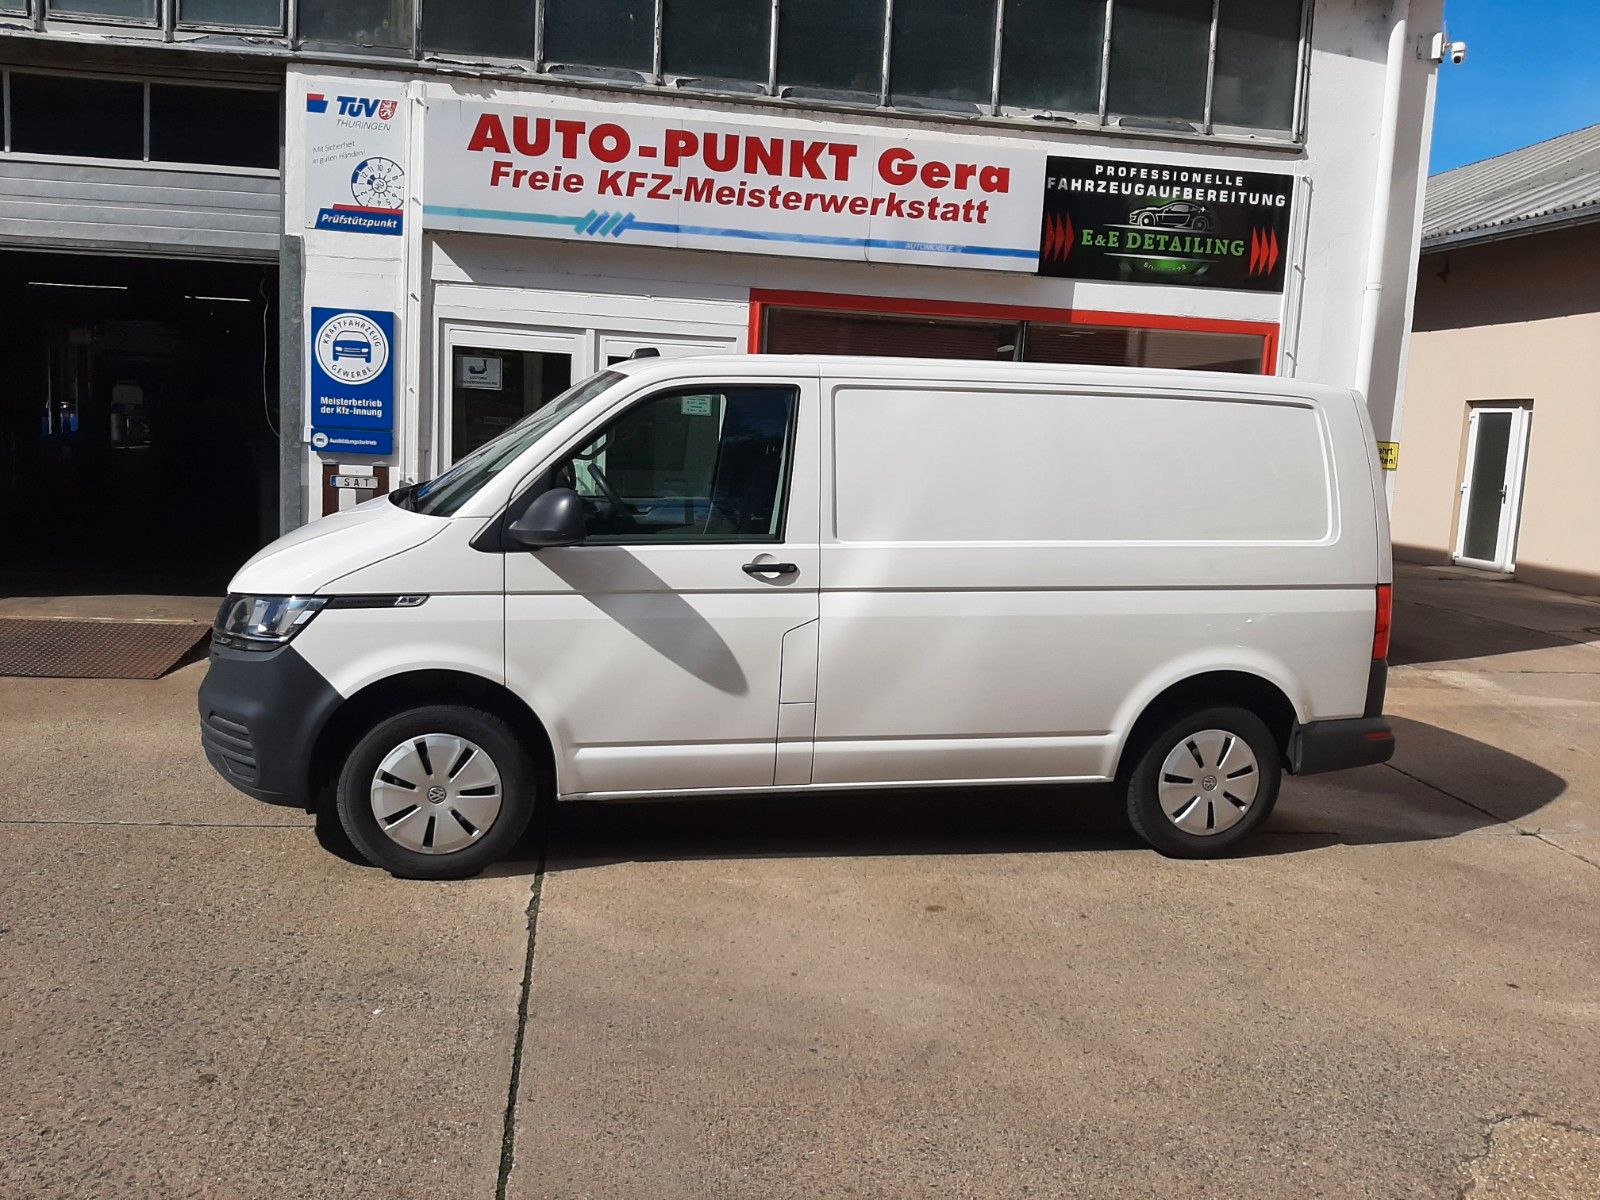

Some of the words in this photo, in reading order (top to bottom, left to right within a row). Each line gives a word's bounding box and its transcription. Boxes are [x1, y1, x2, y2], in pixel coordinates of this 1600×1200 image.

[336, 95, 380, 118] TÜV
[467, 113, 857, 181] AUTO-PUNKT
[877, 147, 1010, 193] Gera
[1095, 164, 1244, 187] PROFESSIONELLE
[490, 161, 585, 193] Freie
[597, 170, 989, 224] KFZ-Meisterwerkstatt
[1047, 176, 1286, 207] FAHRZEUGAUFBEREITUNG
[321, 213, 398, 229] Prüfstützpunkt
[1081, 229, 1120, 247] E&E
[1127, 232, 1245, 256] DETAILING
[323, 320, 381, 347] KRAFTFAHRZEUG
[332, 364, 373, 378] GEWERBE
[320, 396, 383, 408] Meisterbetrieb
[320, 405, 334, 414] der
[336, 406, 383, 418] Kfz-Innung
